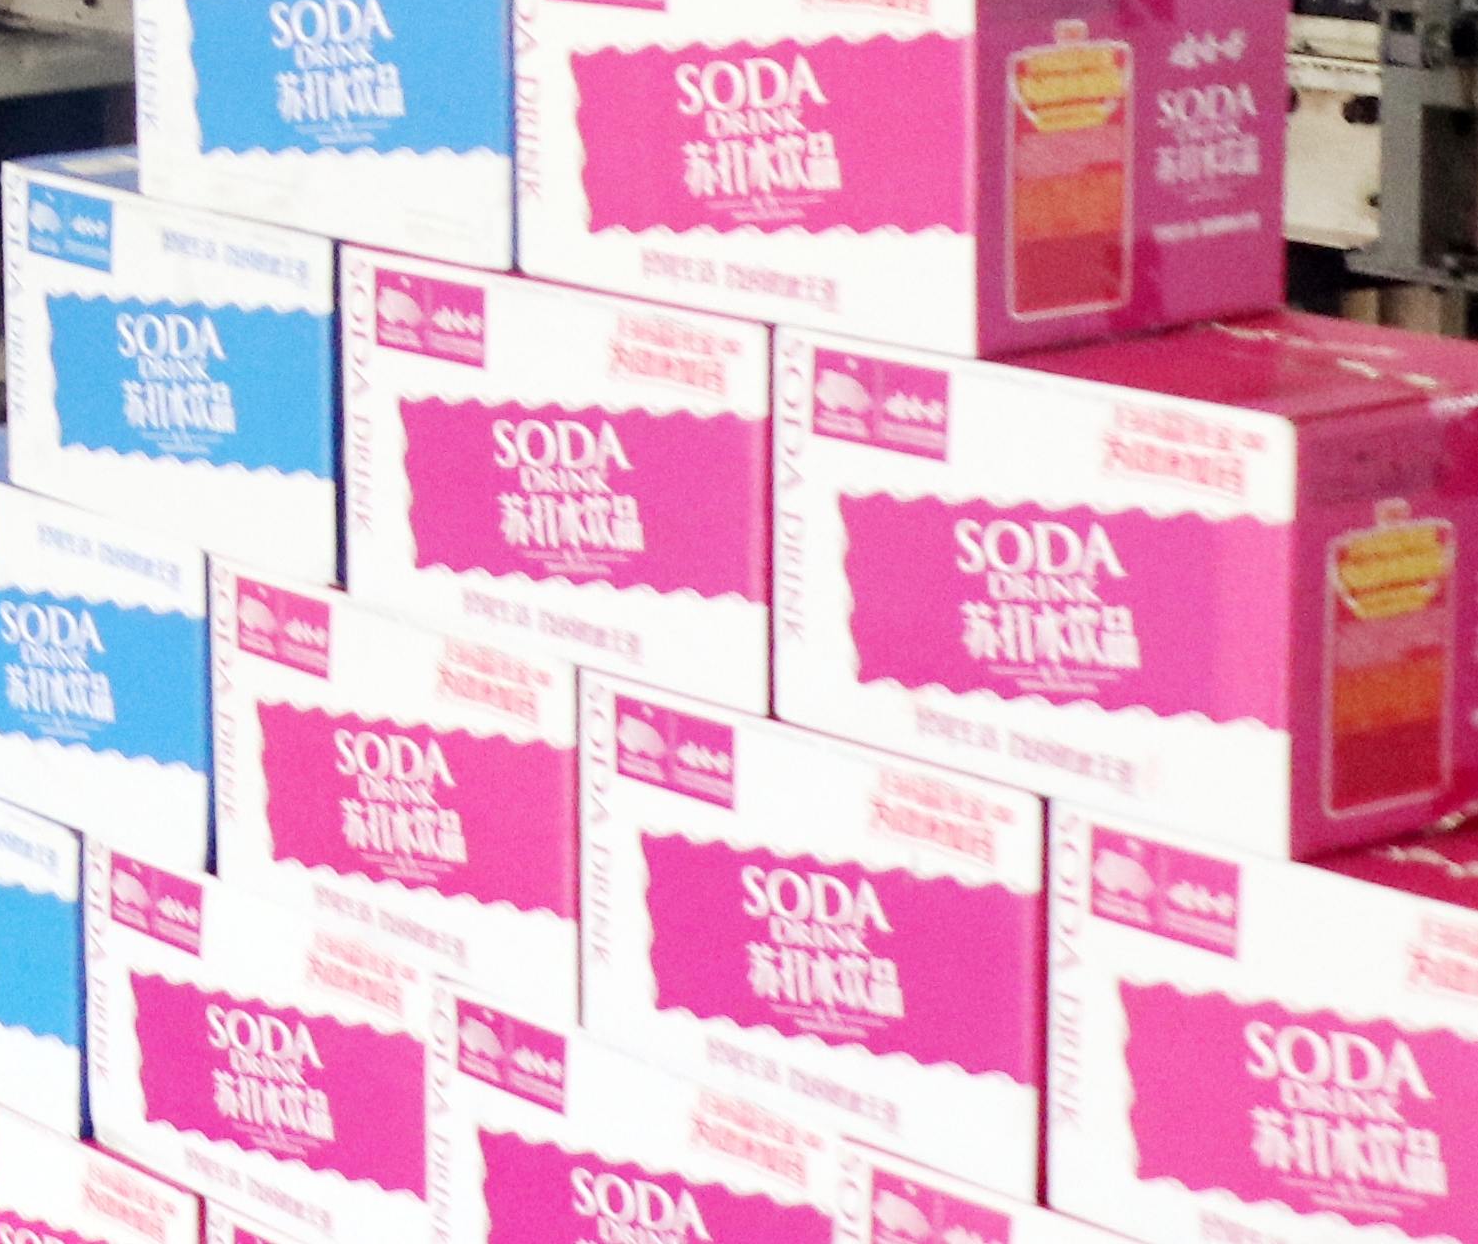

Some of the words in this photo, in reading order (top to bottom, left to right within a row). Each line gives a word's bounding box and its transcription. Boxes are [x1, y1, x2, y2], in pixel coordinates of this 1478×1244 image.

[676, 53, 829, 116] SODA
[1157, 83, 1257, 127] SODA
[116, 312, 226, 360] SODA
[492, 418, 634, 471] SODA
[953, 518, 1129, 579] SODA
[334, 727, 456, 788] SODA
[742, 865, 894, 934] SODA
[205, 1003, 324, 1069] SODA
[1245, 1020, 1437, 1100] SODA
[570, 1166, 714, 1242] SODA
